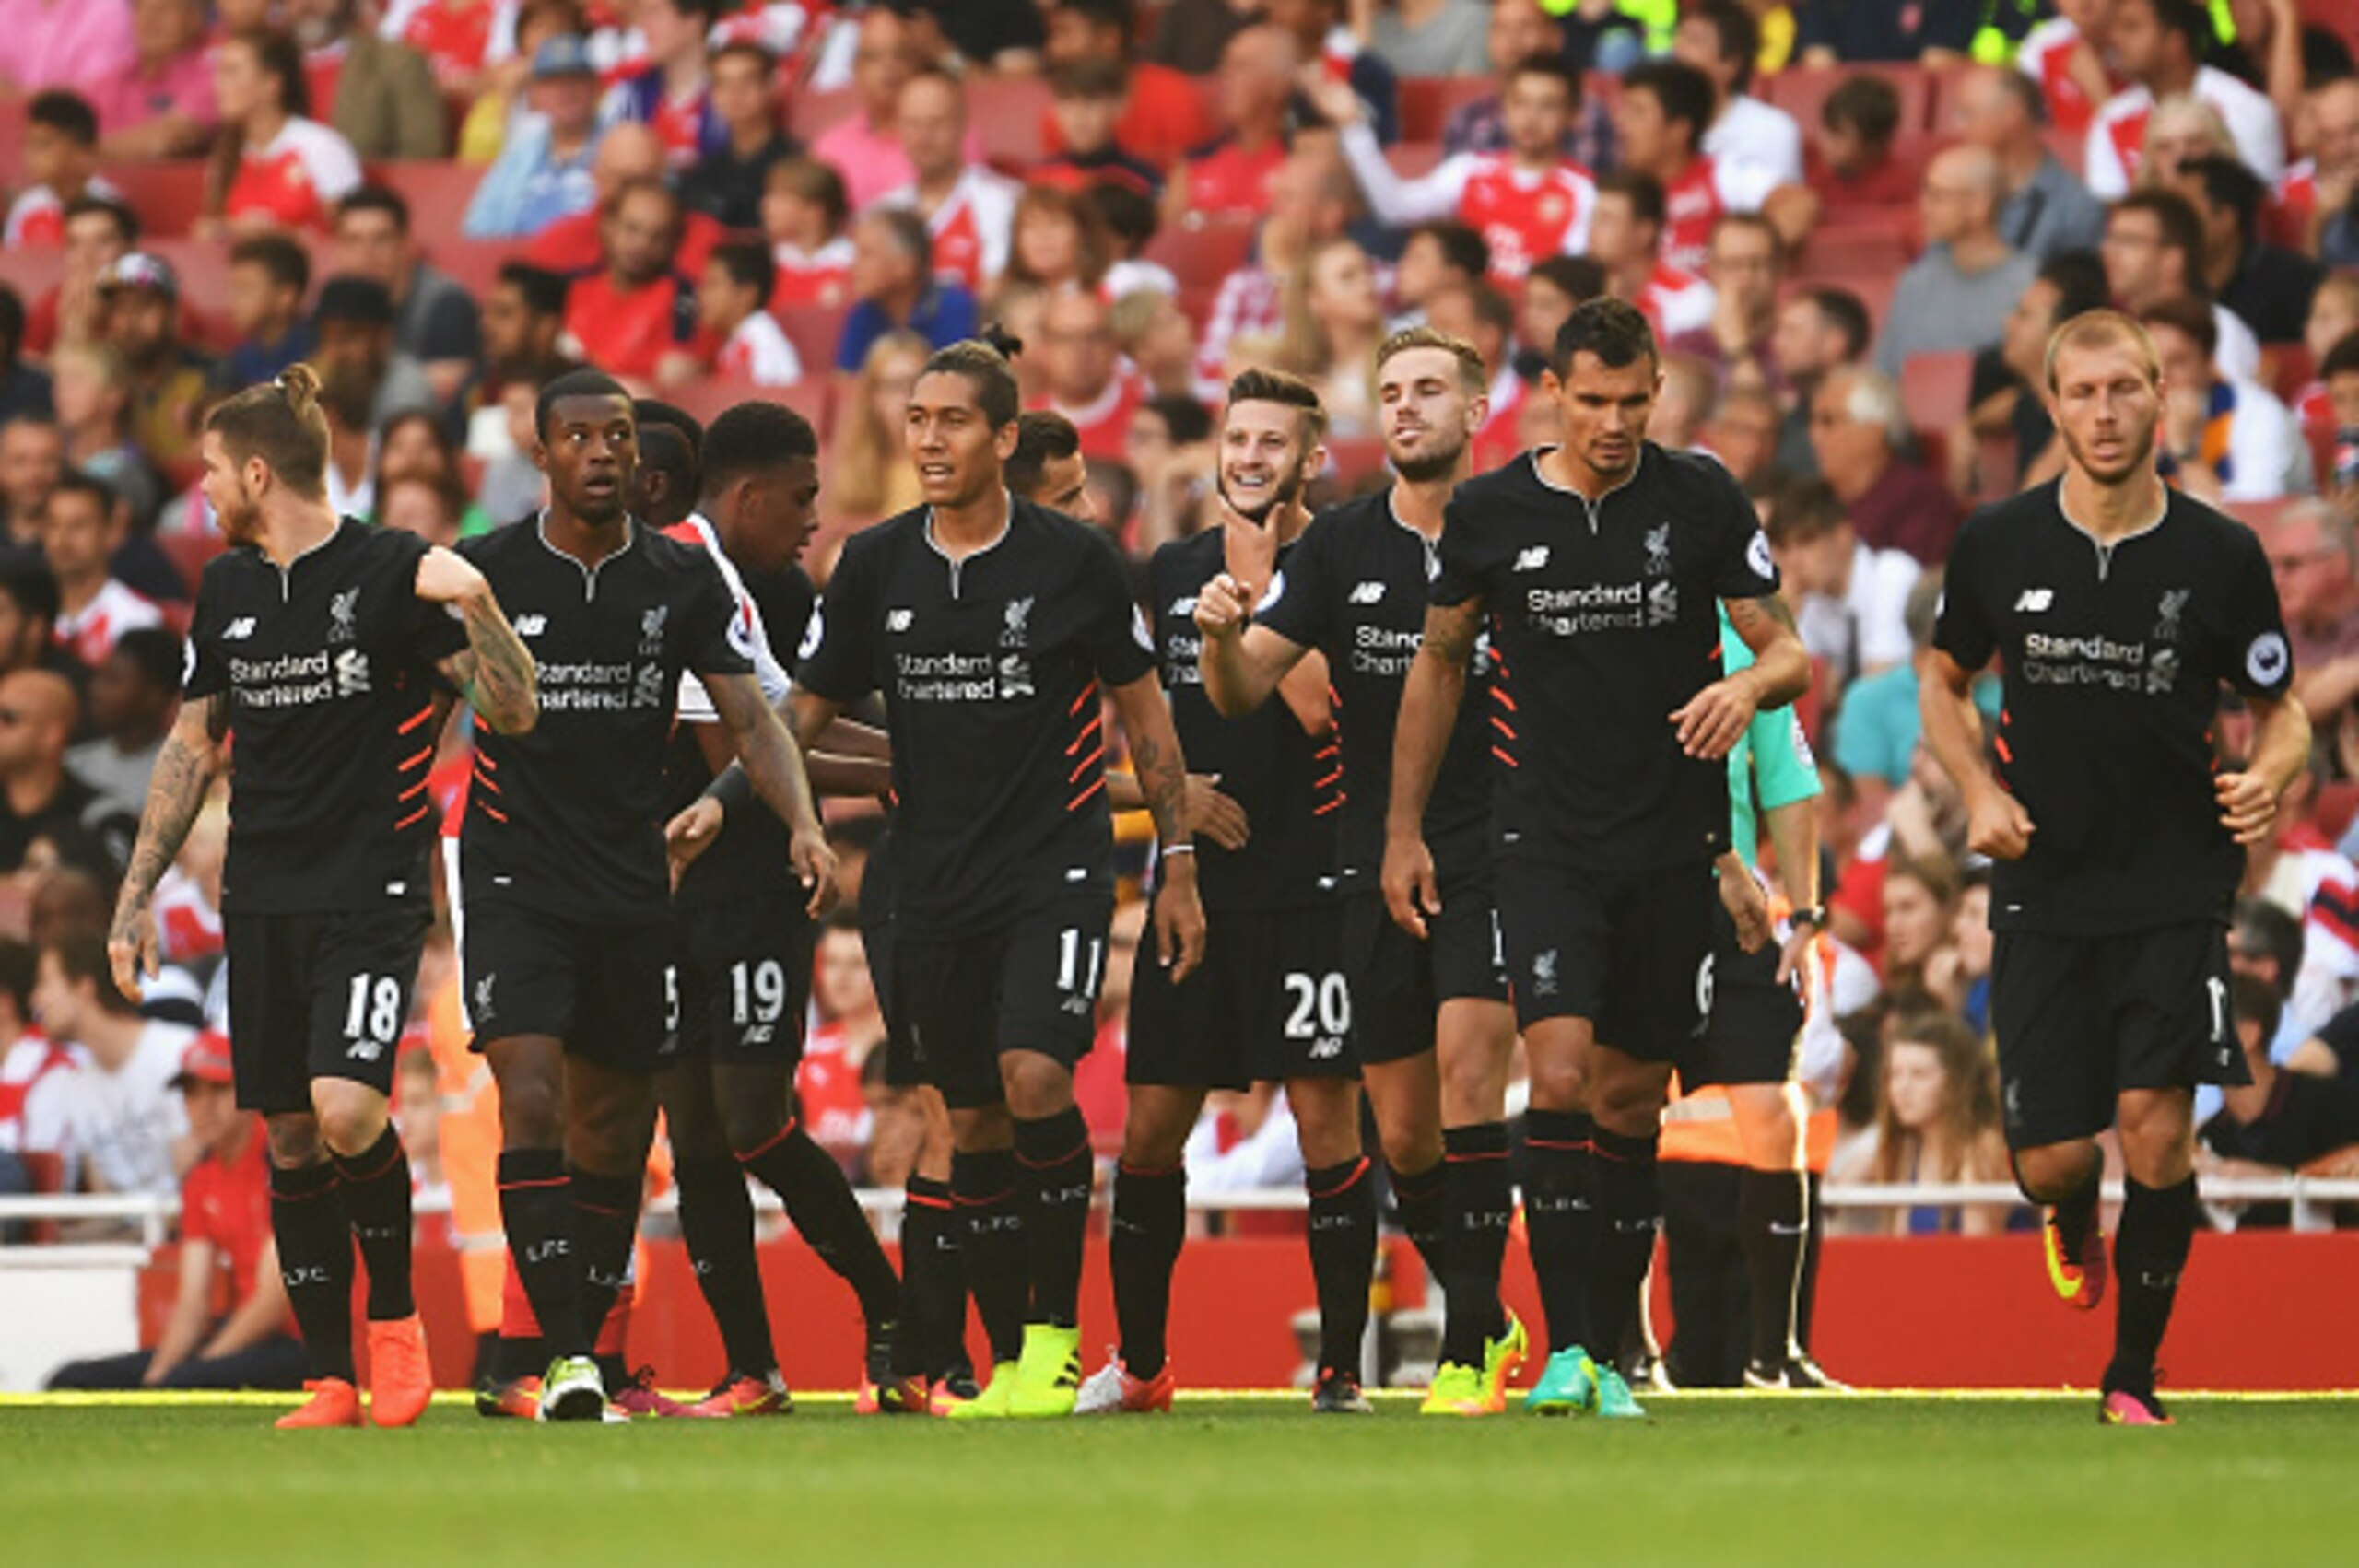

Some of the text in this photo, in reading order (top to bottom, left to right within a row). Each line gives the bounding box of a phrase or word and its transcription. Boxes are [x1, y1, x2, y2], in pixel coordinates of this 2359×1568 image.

[1512, 545, 1550, 571] NB
[1348, 581, 1387, 603] NB
[1527, 581, 1641, 612] Standard
[2014, 590, 2054, 611] NB
[221, 616, 257, 639] NB
[513, 614, 548, 636] NB
[886, 610, 915, 631] NB
[1525, 607, 1642, 636] Chartered
[894, 653, 992, 675] Standard
[2025, 633, 2145, 665] Standard
[229, 649, 329, 683] Standard
[2023, 661, 2142, 692] Chartered
[1056, 929, 1102, 998] 11
[731, 959, 786, 1024] 19
[1696, 952, 1715, 1015] 6
[342, 973, 402, 1044] 18
[1284, 972, 1351, 1038] 20
